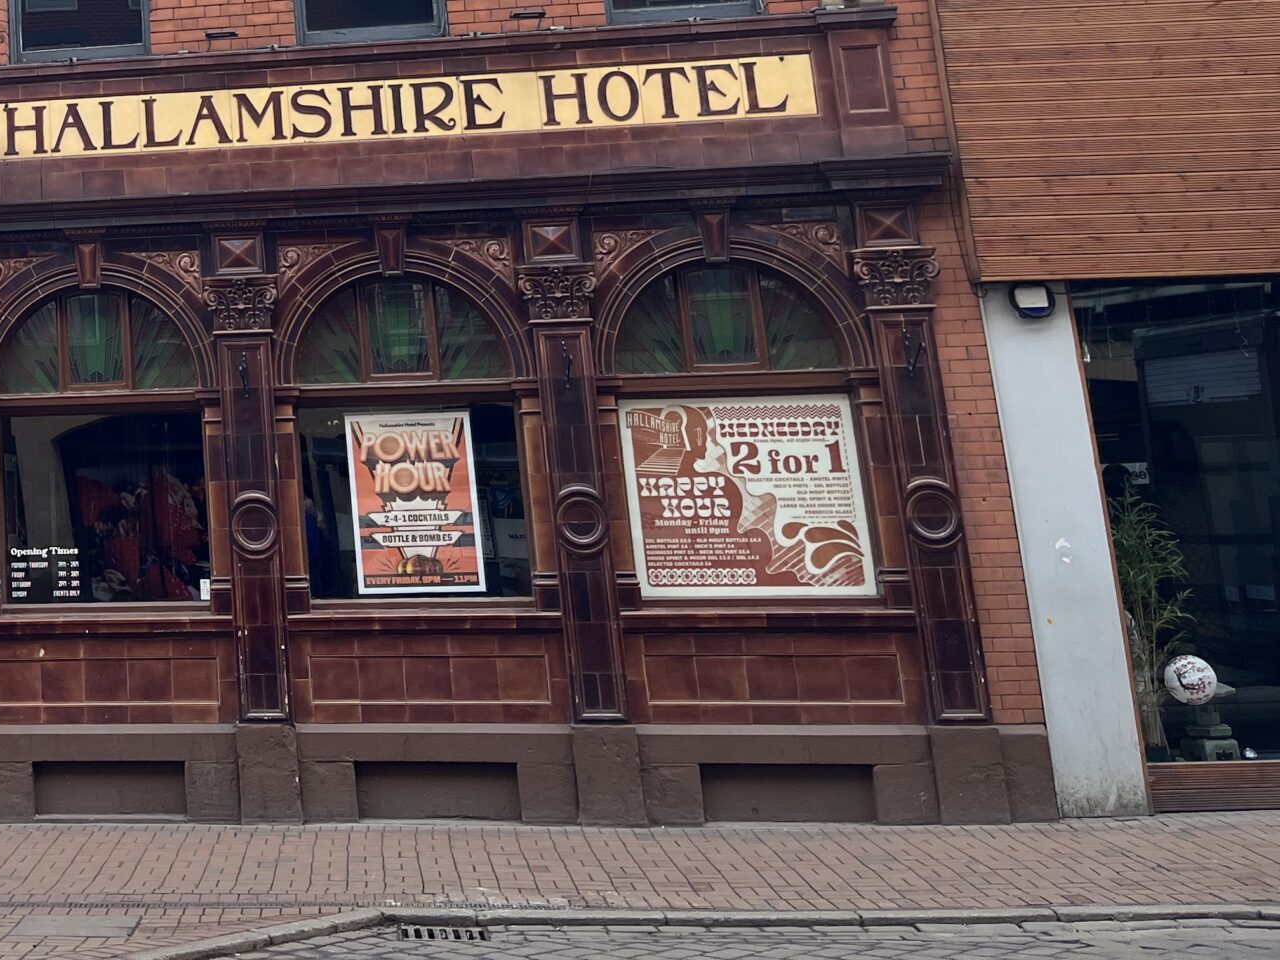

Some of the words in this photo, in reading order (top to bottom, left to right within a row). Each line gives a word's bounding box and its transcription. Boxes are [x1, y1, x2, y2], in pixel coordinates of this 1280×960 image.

[4, 77, 506, 156] HALLAMSHIRE
[541, 60, 789, 126] HOTEL
[626, 413, 680, 432] HALLAMSHIRE
[719, 421, 840, 438] WEDNESDAY
[360, 429, 461, 462] POWER
[659, 432, 681, 444] HOTEL
[730, 441, 761, 474] 2
[768, 449, 819, 474] for
[825, 440, 847, 473] 1
[373, 460, 452, 494] HOUR
[639, 476, 725, 497] HAPPY
[661, 497, 731, 517] HOUR
[384, 515, 407, 523] 2-4-1
[407, 513, 449, 523] COCKTAILS
[655, 519, 692, 527] Monday
[699, 518, 730, 526] Friday
[382, 534, 410, 543] BOTTLE
[418, 534, 442, 542] BOMB
[442, 533, 453, 541] £5
[708, 527, 730, 535] 9pm
[10, 547, 48, 558] Opening
[49, 546, 79, 555] Times
[366, 576, 392, 585] EVERY
